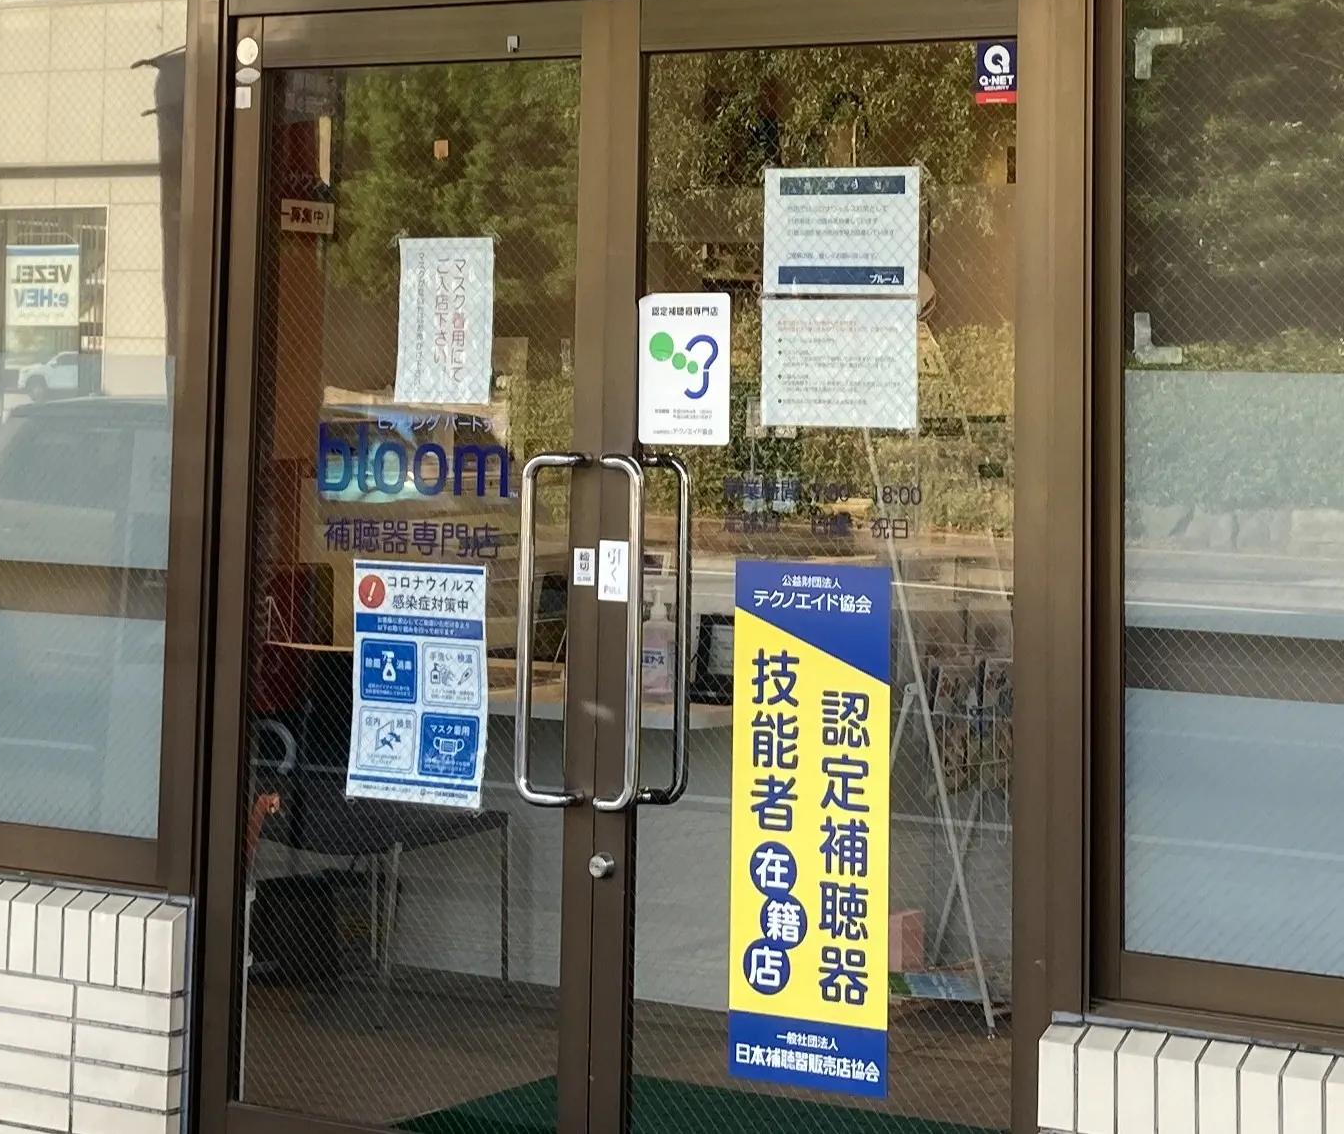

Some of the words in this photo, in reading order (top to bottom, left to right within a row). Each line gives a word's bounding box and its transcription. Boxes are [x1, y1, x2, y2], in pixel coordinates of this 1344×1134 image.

[869, 273, 900, 284] ブルーム
[317, 422, 510, 498] bloom
[324, 518, 502, 559] 補聴器専門店
[387, 576, 475, 593] コロナウイルス
[782, 574, 842, 589] 公益財団法人
[392, 594, 469, 613] 感染症対策中
[753, 590, 873, 614] テクノエイド協会
[750, 648, 800, 832] 技能者
[819, 690, 871, 1006] 認定補聴器
[748, 847, 802, 988] 在籍店
[776, 1033, 839, 1051] 一般社団法人
[735, 1042, 880, 1083] 日本補聴器販売店協会
